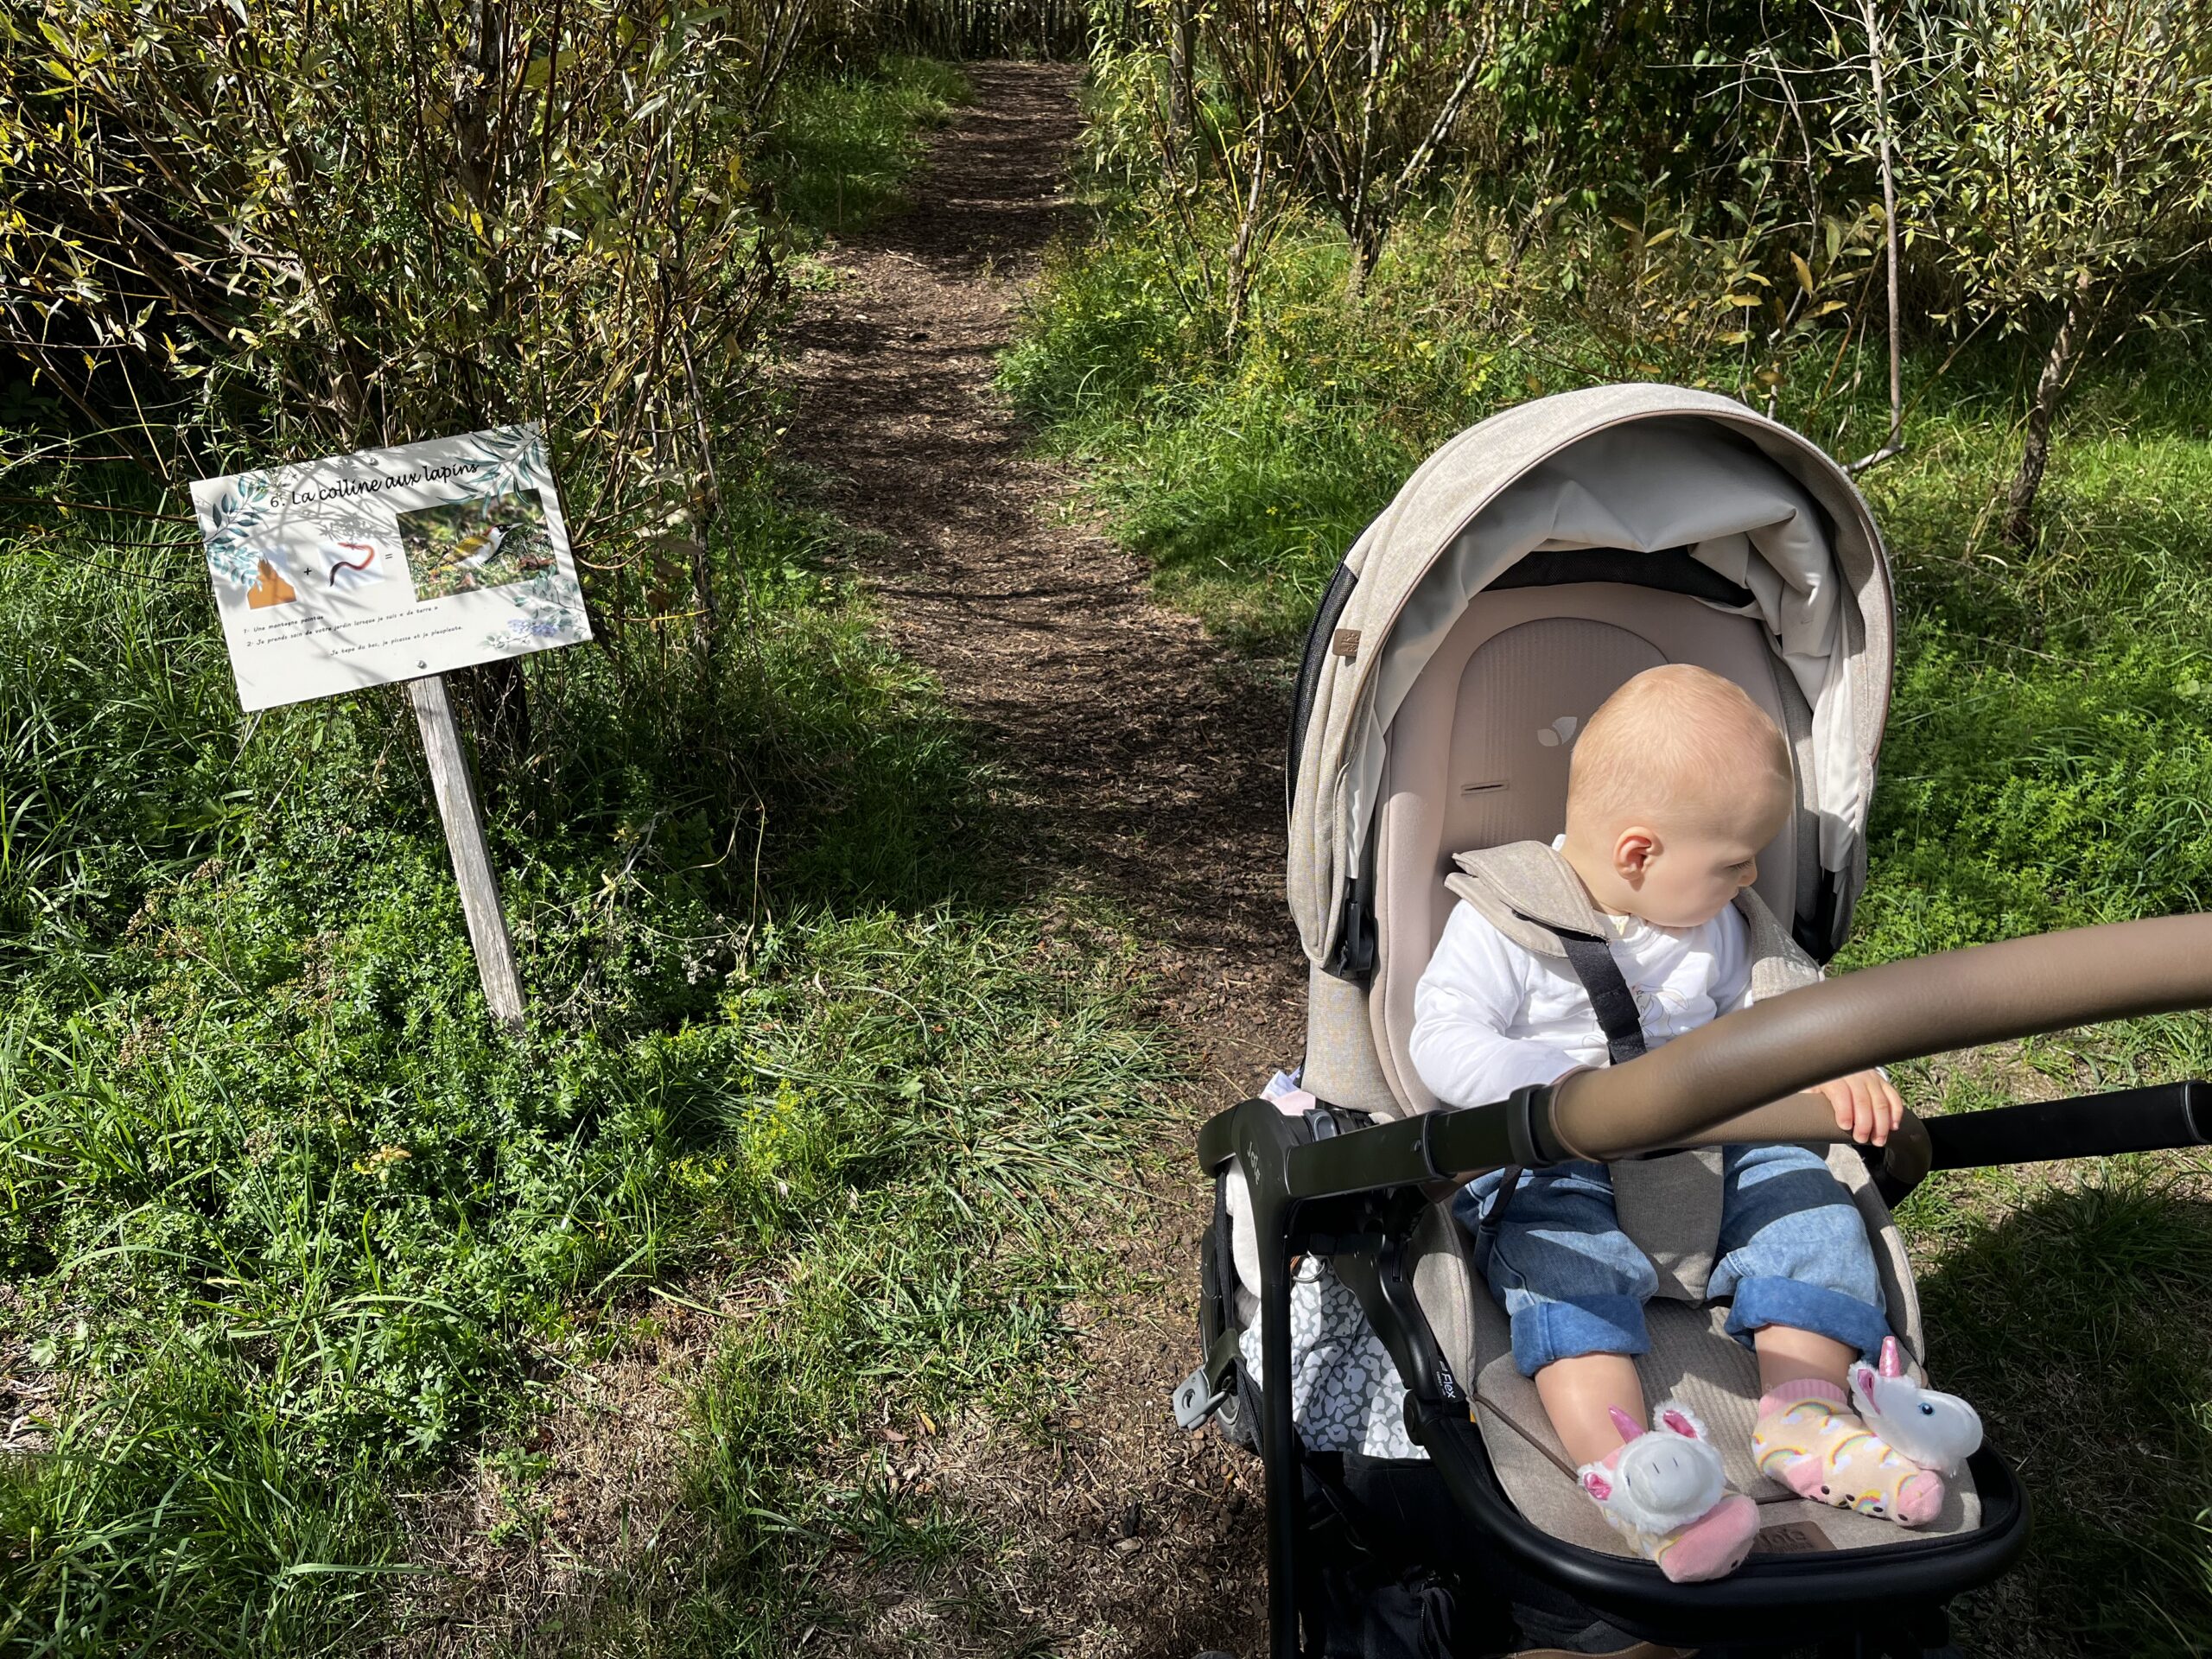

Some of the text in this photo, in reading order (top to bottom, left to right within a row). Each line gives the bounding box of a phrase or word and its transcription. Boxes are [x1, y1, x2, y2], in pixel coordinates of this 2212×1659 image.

[270, 463, 480, 508] 6. La colline aux lapins
[267, 634, 288, 644] prends
[334, 622, 352, 632] jardin
[353, 617, 376, 626] lorsque
[268, 620, 298, 630] montagne
[1246, 1141, 1262, 1185] Joie
[1441, 1372, 1457, 1399] Flex
